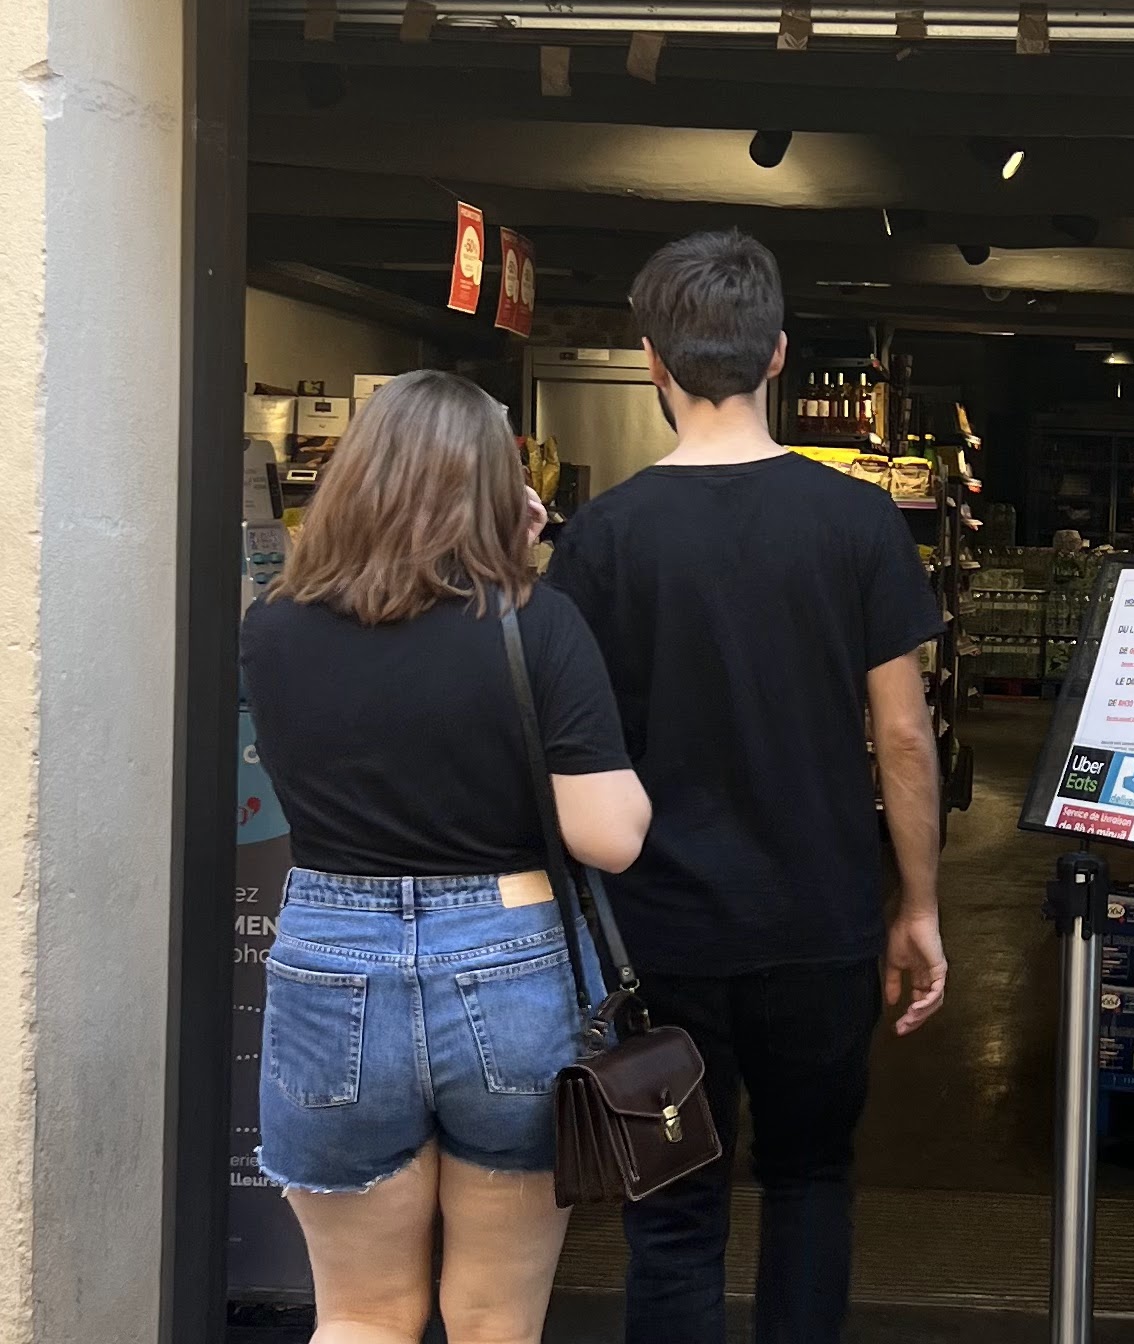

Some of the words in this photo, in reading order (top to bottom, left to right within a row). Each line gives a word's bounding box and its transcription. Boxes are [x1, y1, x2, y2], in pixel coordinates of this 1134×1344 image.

[1072, 754, 1105, 774] Uber
[1065, 772, 1098, 793] Eats
[1062, 807, 1089, 818] Service
[1089, 811, 1099, 821] de
